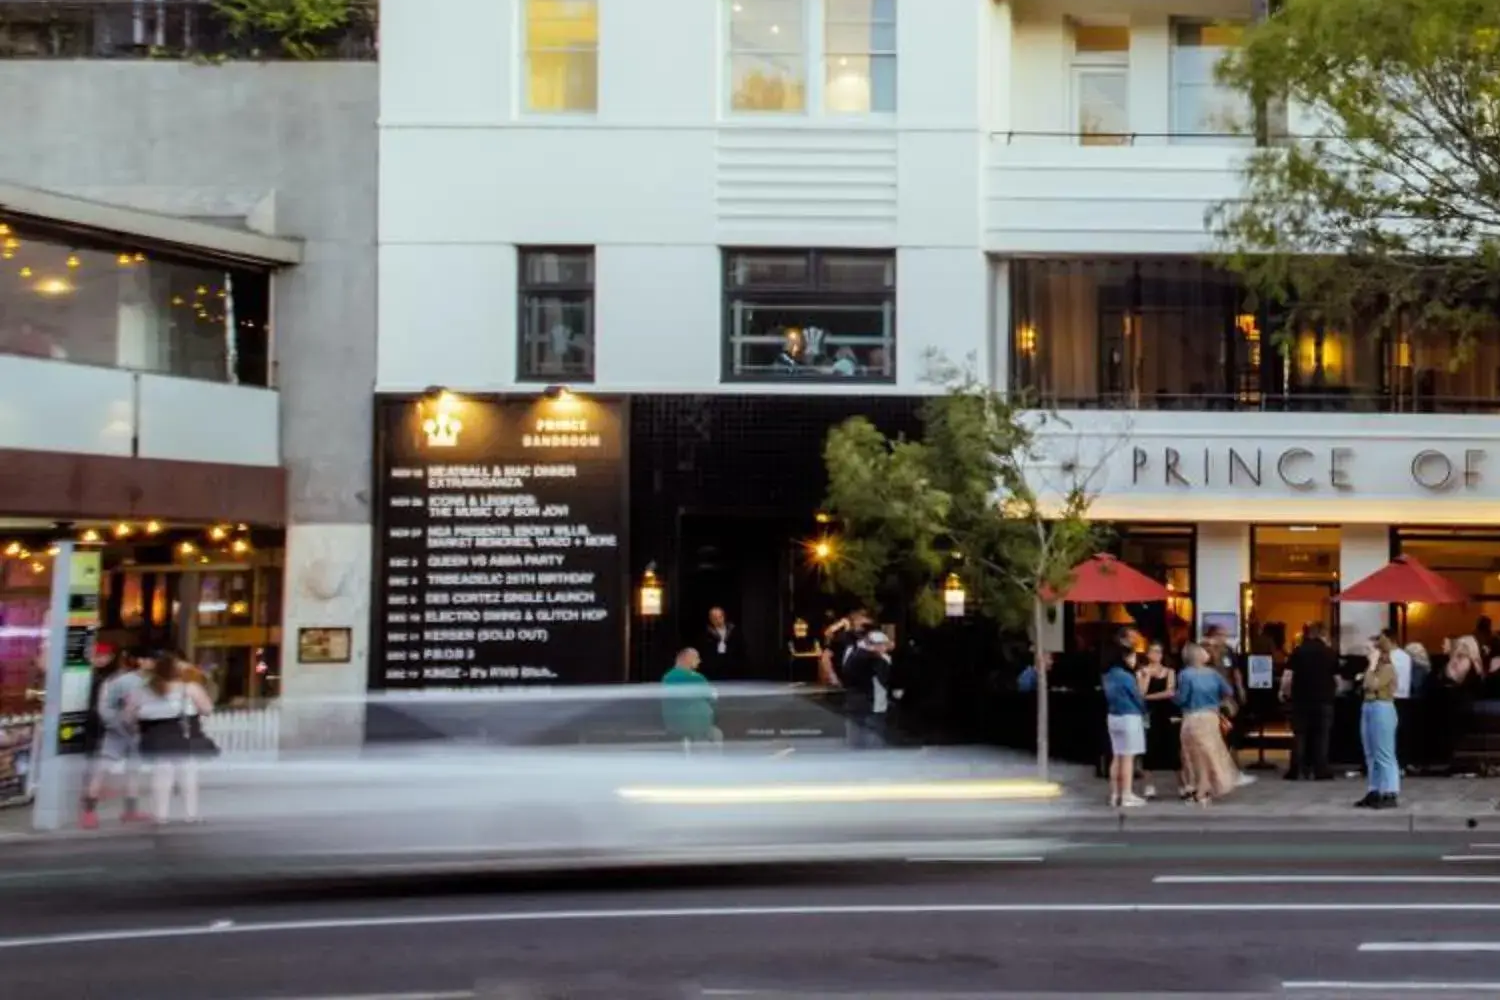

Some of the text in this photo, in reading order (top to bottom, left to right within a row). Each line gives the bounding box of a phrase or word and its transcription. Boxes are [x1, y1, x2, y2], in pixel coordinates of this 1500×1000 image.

[522, 434, 601, 447] BANDROOM
[1132, 446, 1353, 491] PRINCE
[1411, 448, 1487, 491] OF
[429, 504, 569, 517] THE MUSIC OF BON JOVI
[427, 554, 469, 567] QUEEN
[470, 554, 487, 567] VS
[488, 554, 522, 567] ABBA
[523, 554, 565, 566] PARTY
[537, 572, 595, 585] BIRTHDAY
[546, 591, 595, 603] LAUNCH
[425, 610, 480, 622] ELECTRO
[581, 609, 608, 621] HOP
[477, 628, 516, 643] (SOLD
[518, 628, 549, 643] OUT)
